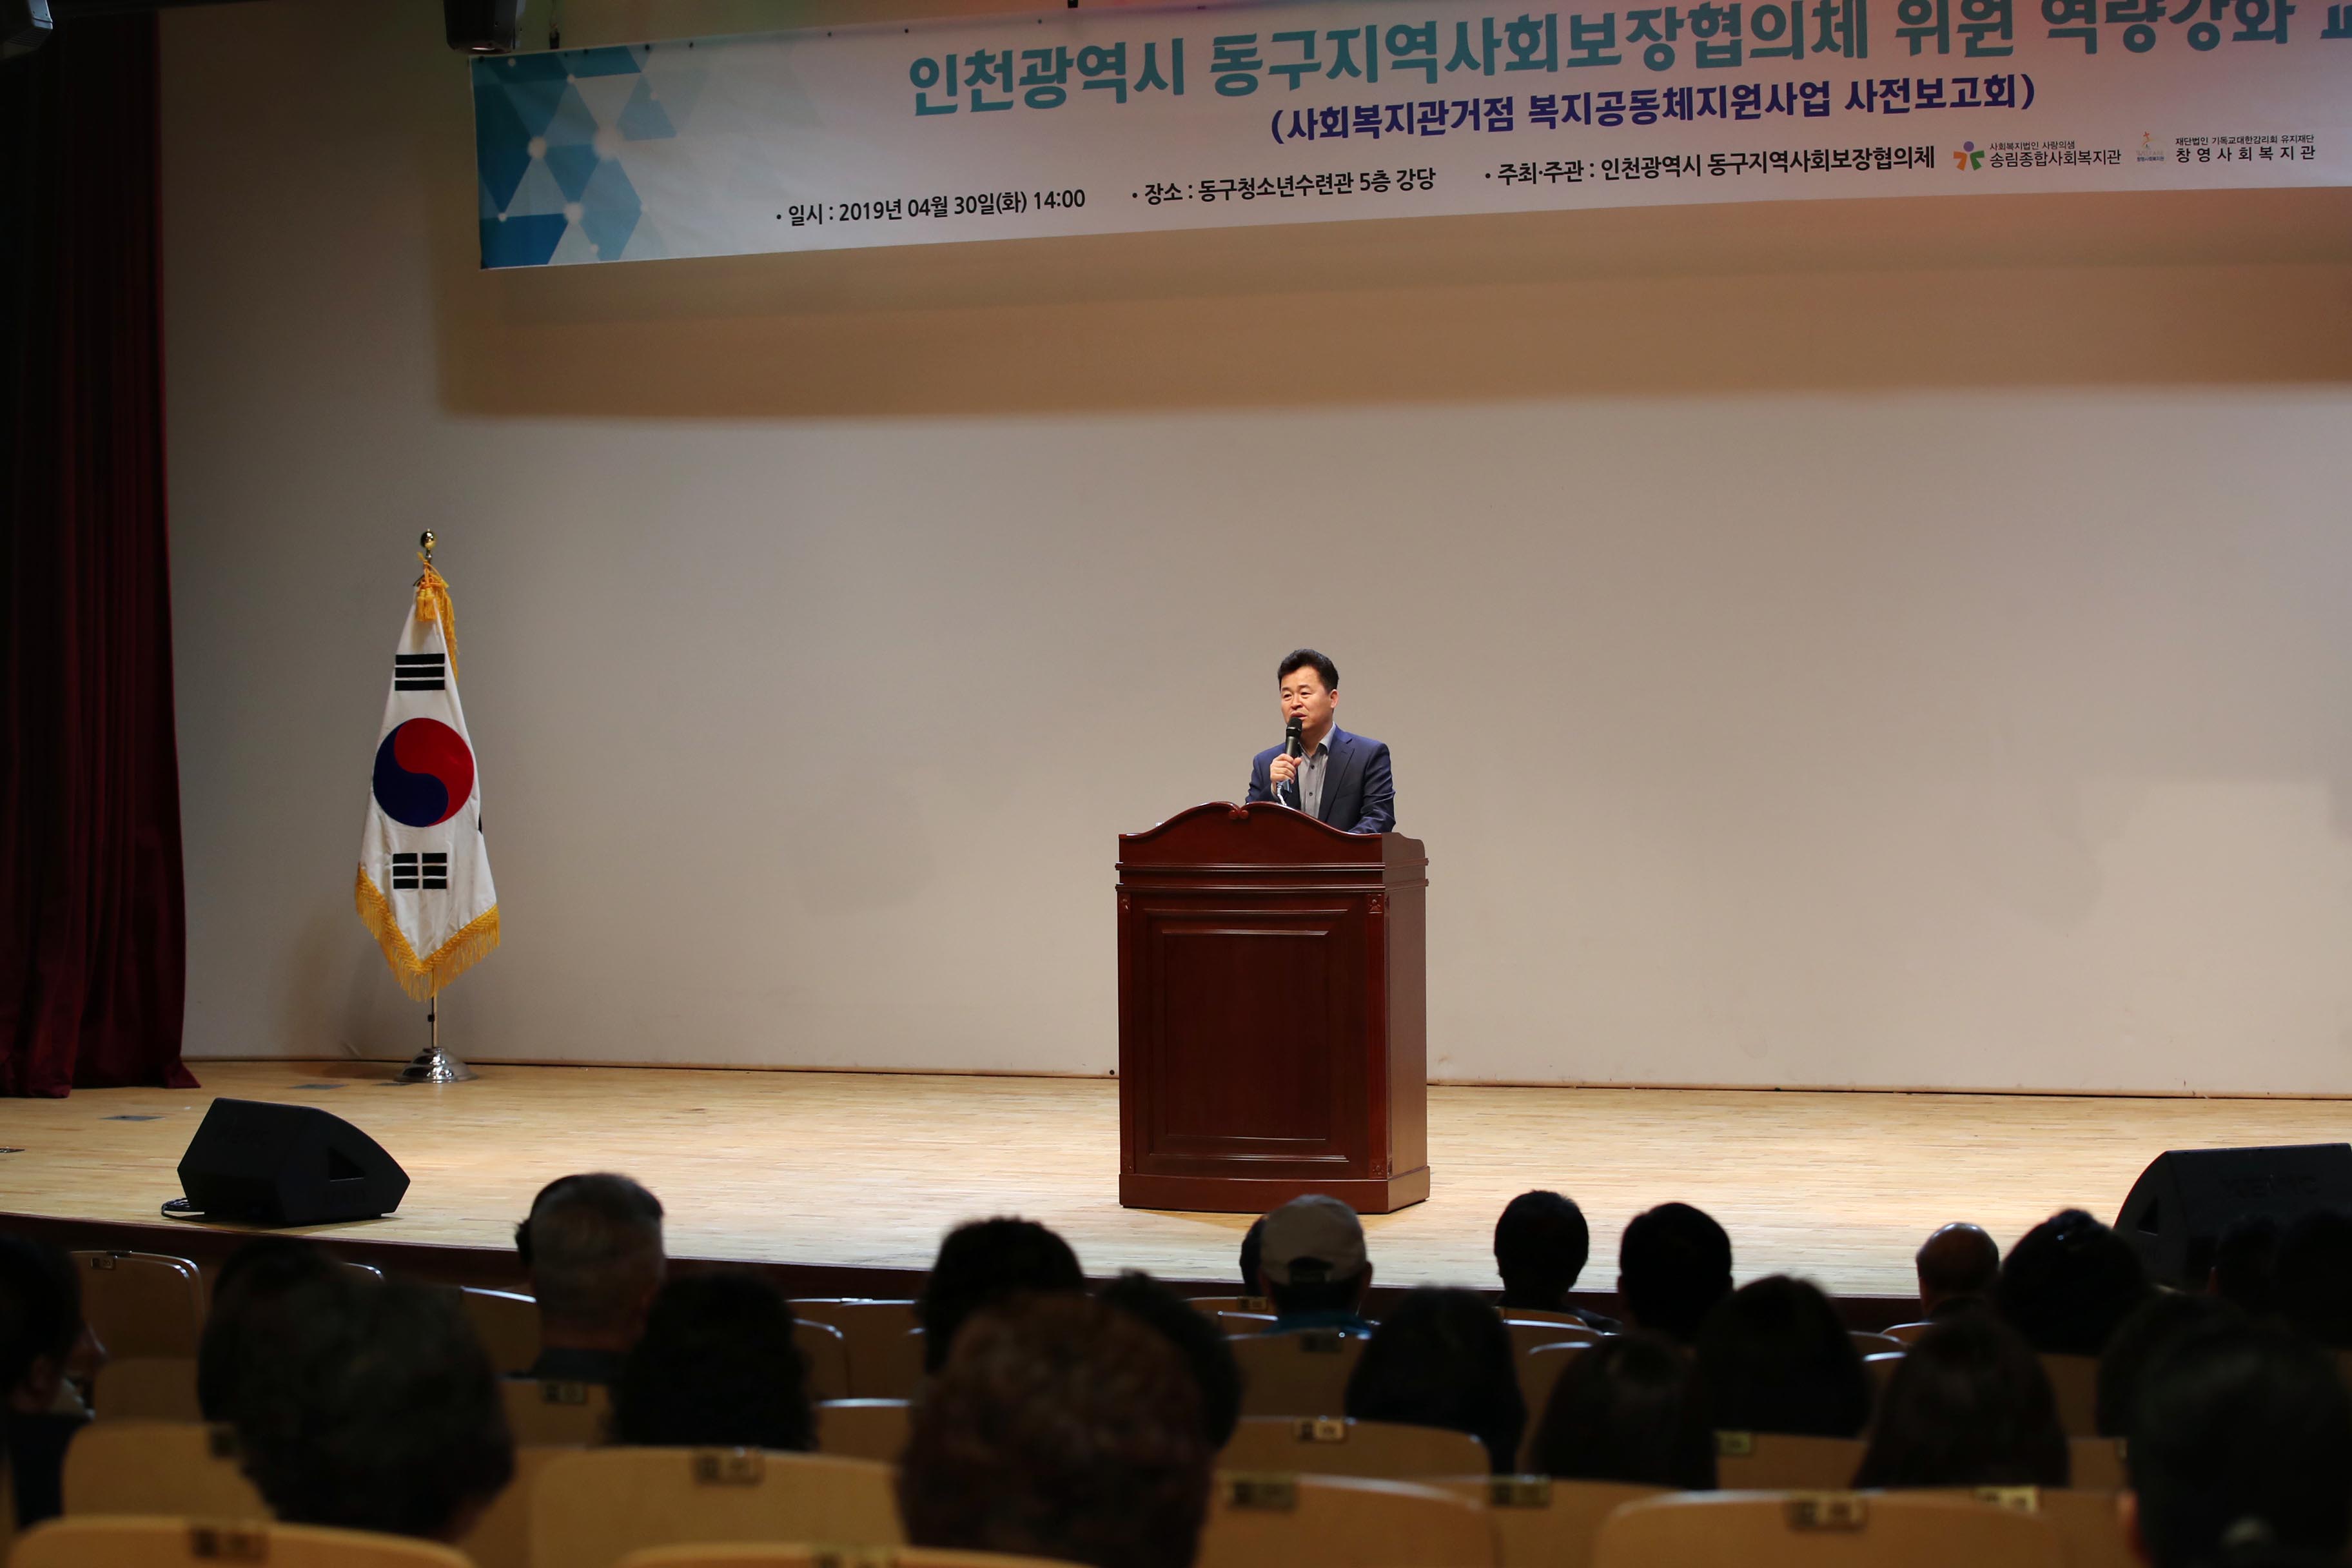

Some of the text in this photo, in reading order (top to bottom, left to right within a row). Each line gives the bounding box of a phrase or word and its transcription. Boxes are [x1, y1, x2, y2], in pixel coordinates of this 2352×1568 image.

[910, 38, 1184, 116] 인천광역시
[1210, 0, 1868, 98] 동구지역사회보장협의체
[1895, 0, 2014, 57] 위원
[1270, 74, 2034, 145] (사회복지관거점 복지공동체지원사업 사전보고회)
[2175, 134, 2314, 146] 재단법인 기독교대한감리회 유지재단
[1602, 155, 1700, 181] 인천광역시
[1707, 146, 1934, 176] 동구지역사회보장협의체
[1990, 149, 2121, 168] 송림종합사회복지관
[1199, 172, 1354, 202] 동구청소년수련관
[1360, 170, 1391, 192] 5층
[1396, 168, 1436, 191] 강당
[839, 199, 902, 221] 2019년
[908, 196, 948, 217] 04월
[954, 191, 1027, 215] 30일(화)
[1034, 190, 1085, 210] 14:00
